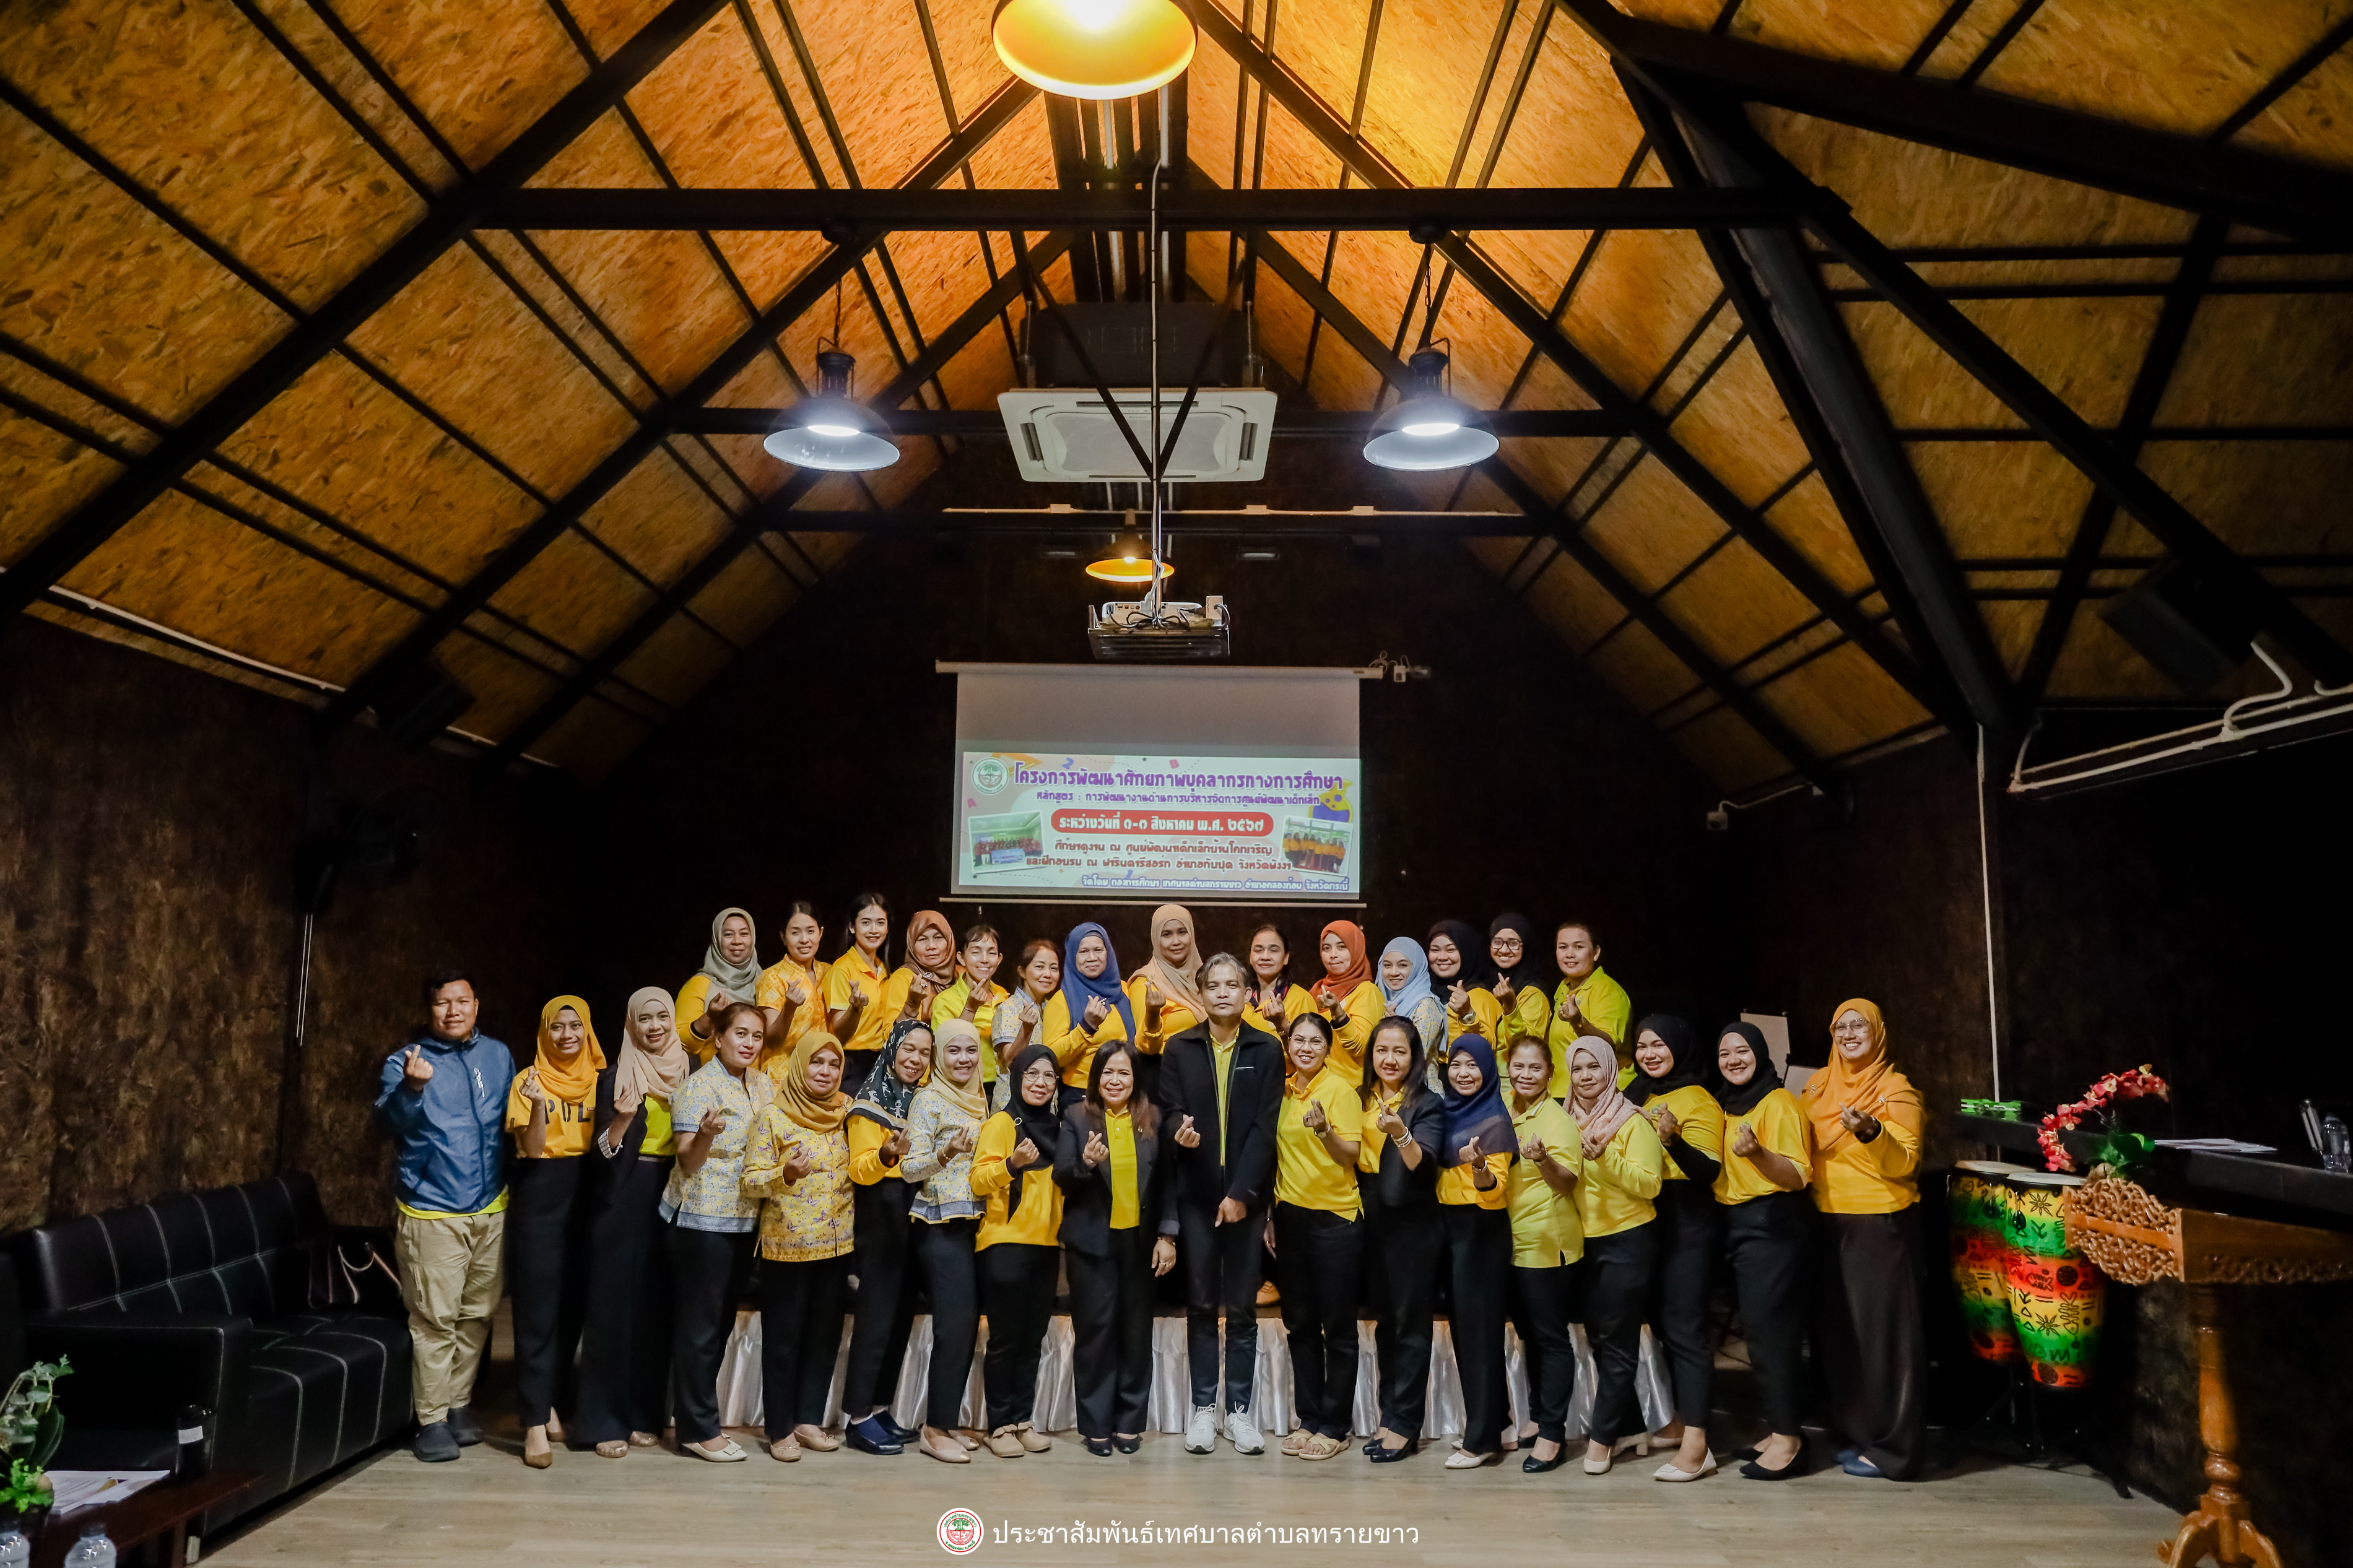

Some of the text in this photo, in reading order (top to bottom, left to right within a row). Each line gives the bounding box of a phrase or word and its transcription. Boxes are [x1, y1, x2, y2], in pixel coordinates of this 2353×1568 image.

[1014, 761, 1343, 792] โครงการพัฒนาศักยภาพบุคลากรทางการศึกษา
[1037, 790, 1074, 803] หลักสูตร
[1059, 811, 1121, 829] ระหว่างวันที่
[1150, 815, 1194, 831] สิงหาคม
[1197, 818, 1224, 831] พ.ศ.
[1227, 818, 1264, 832] ๒๕๖๗
[1055, 839, 1105, 855] ศึกษาดูงาน
